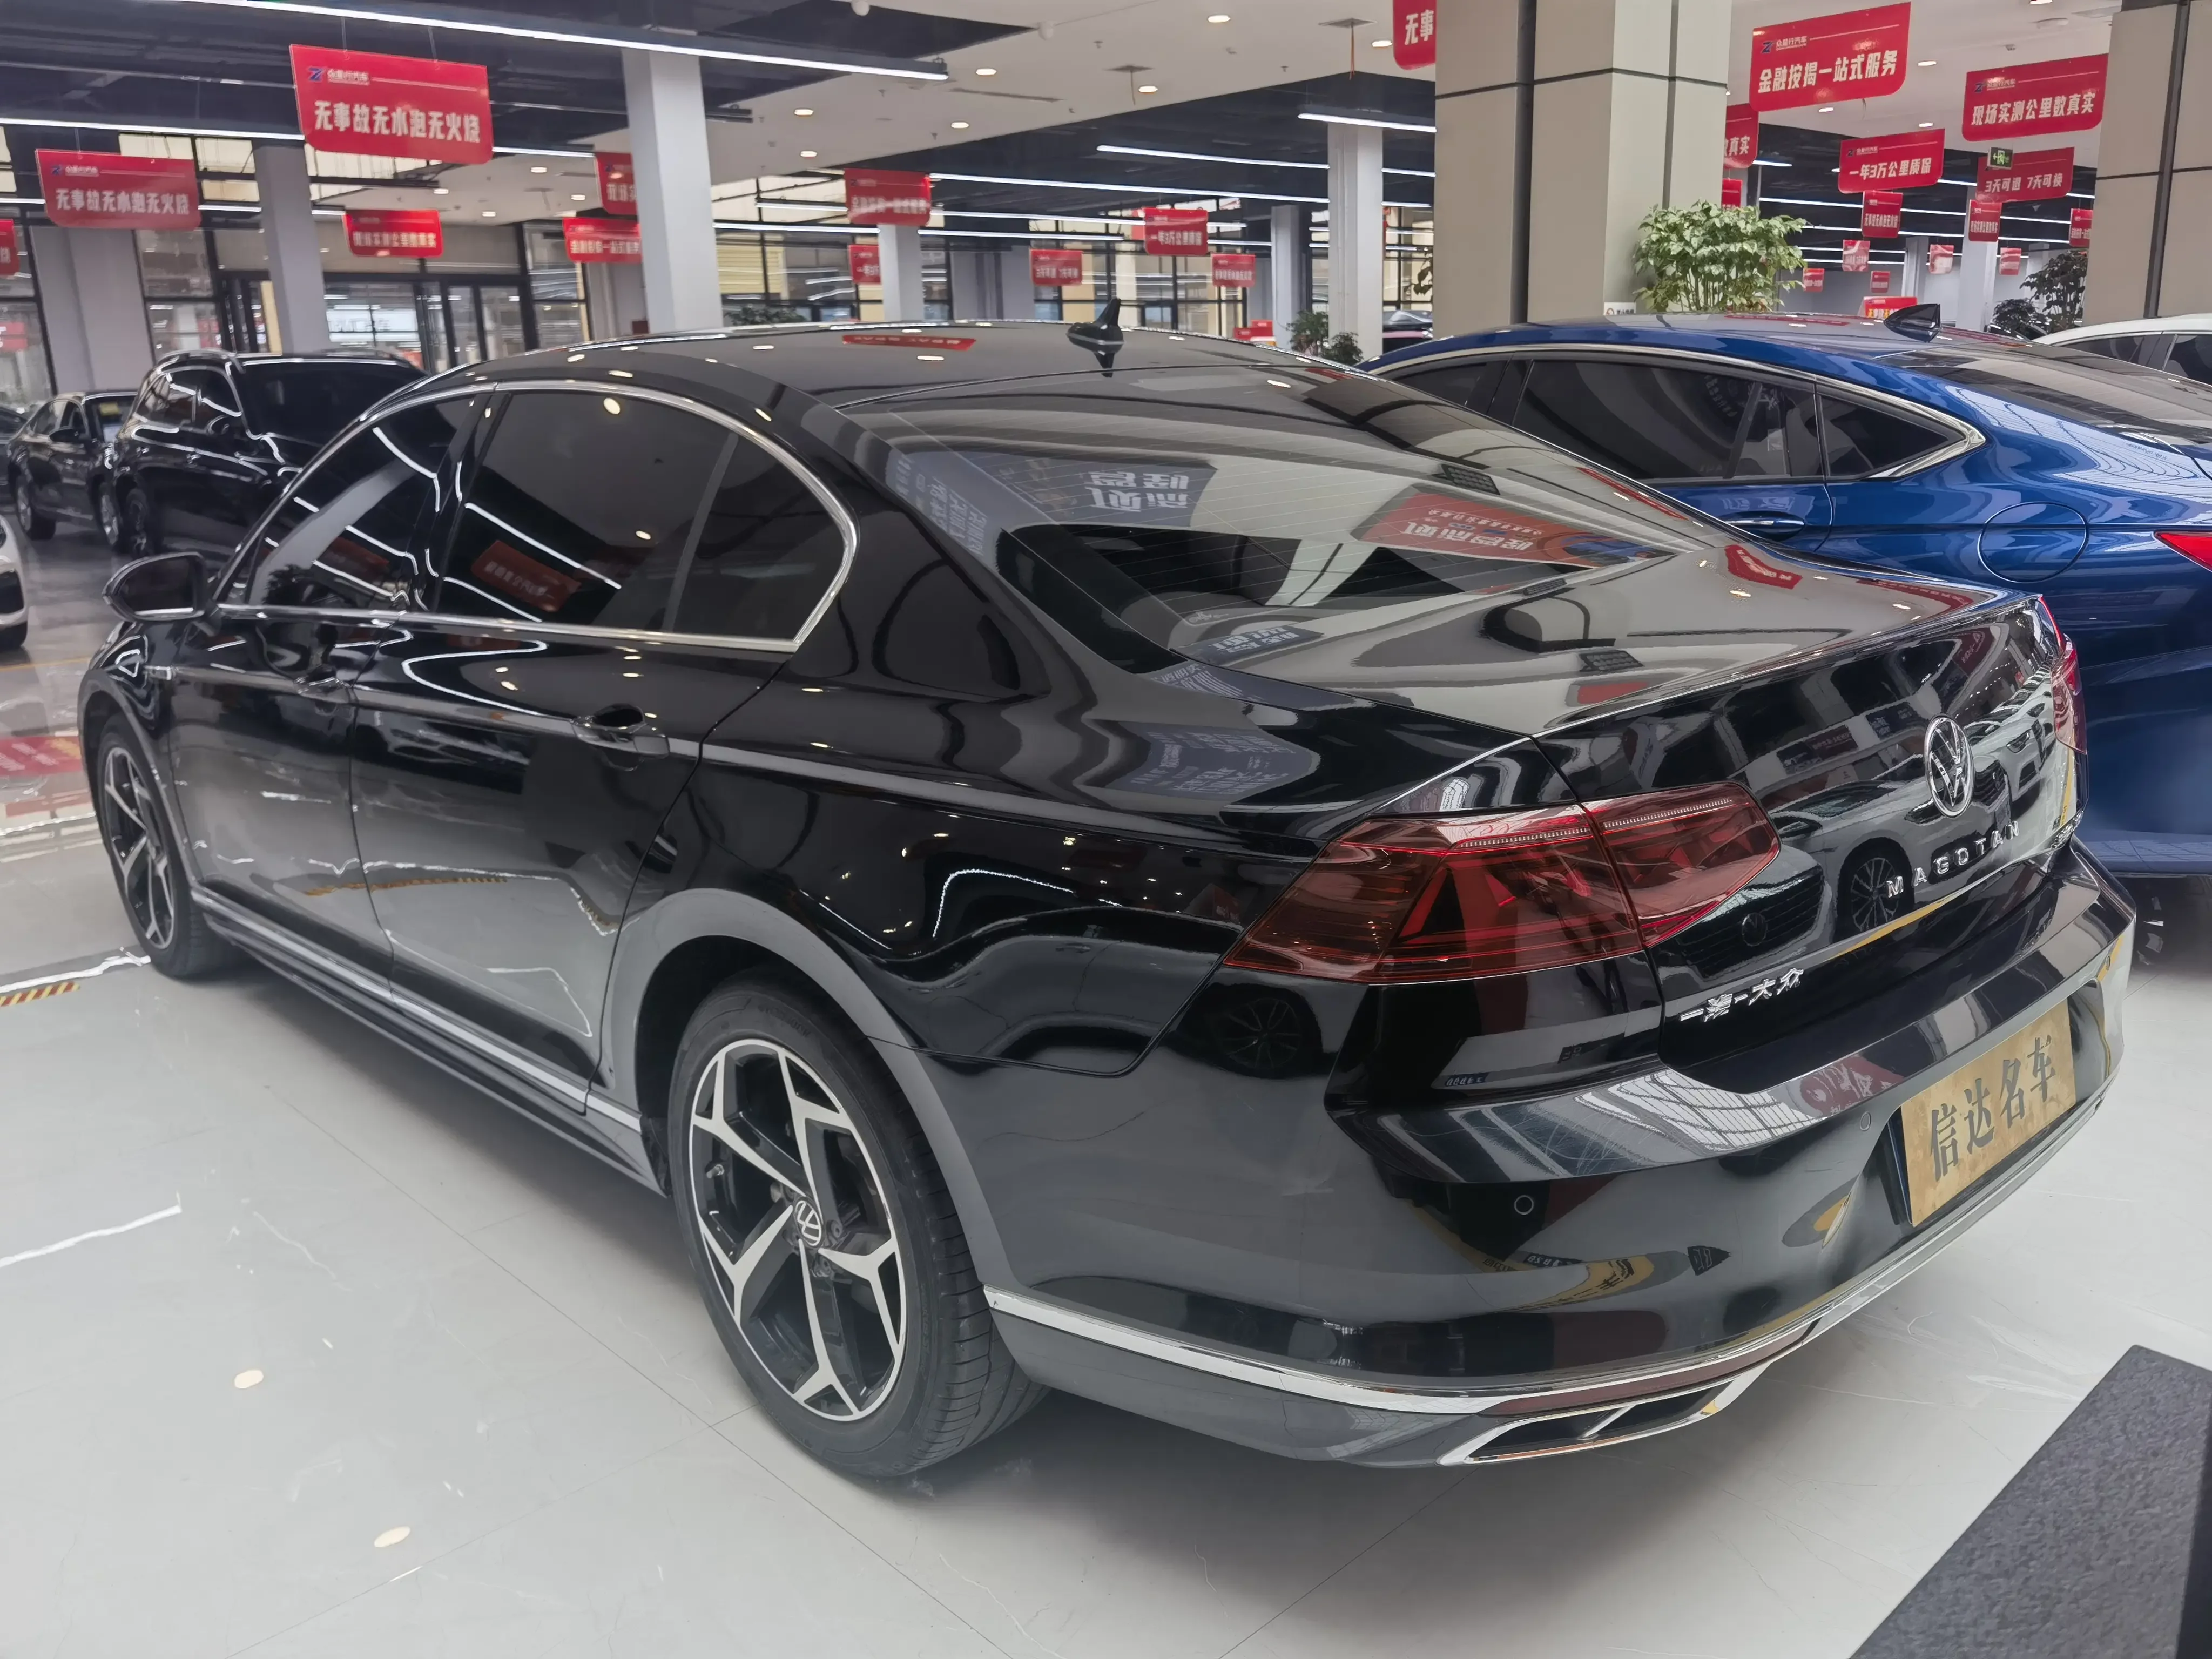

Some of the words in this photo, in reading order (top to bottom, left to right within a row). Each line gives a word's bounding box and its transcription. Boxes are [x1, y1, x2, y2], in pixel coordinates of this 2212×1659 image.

[1405, 9, 1434, 45] 无事
[1758, 50, 1898, 93] 金融按揭一站式服务
[314, 100, 481, 143] 无事故无水泡无火烧
[1971, 91, 2096, 125] 现场实测公里数真实
[1849, 157, 1932, 180] 一年3万公里质保
[1985, 177, 2022, 193] 3天可退
[2026, 172, 2063, 190] 7天可换
[56, 188, 190, 215] 无事故无水泡无火烧
[1886, 821, 2020, 898] MAGOTAN
[1930, 1034, 2056, 1182] 信达名车
